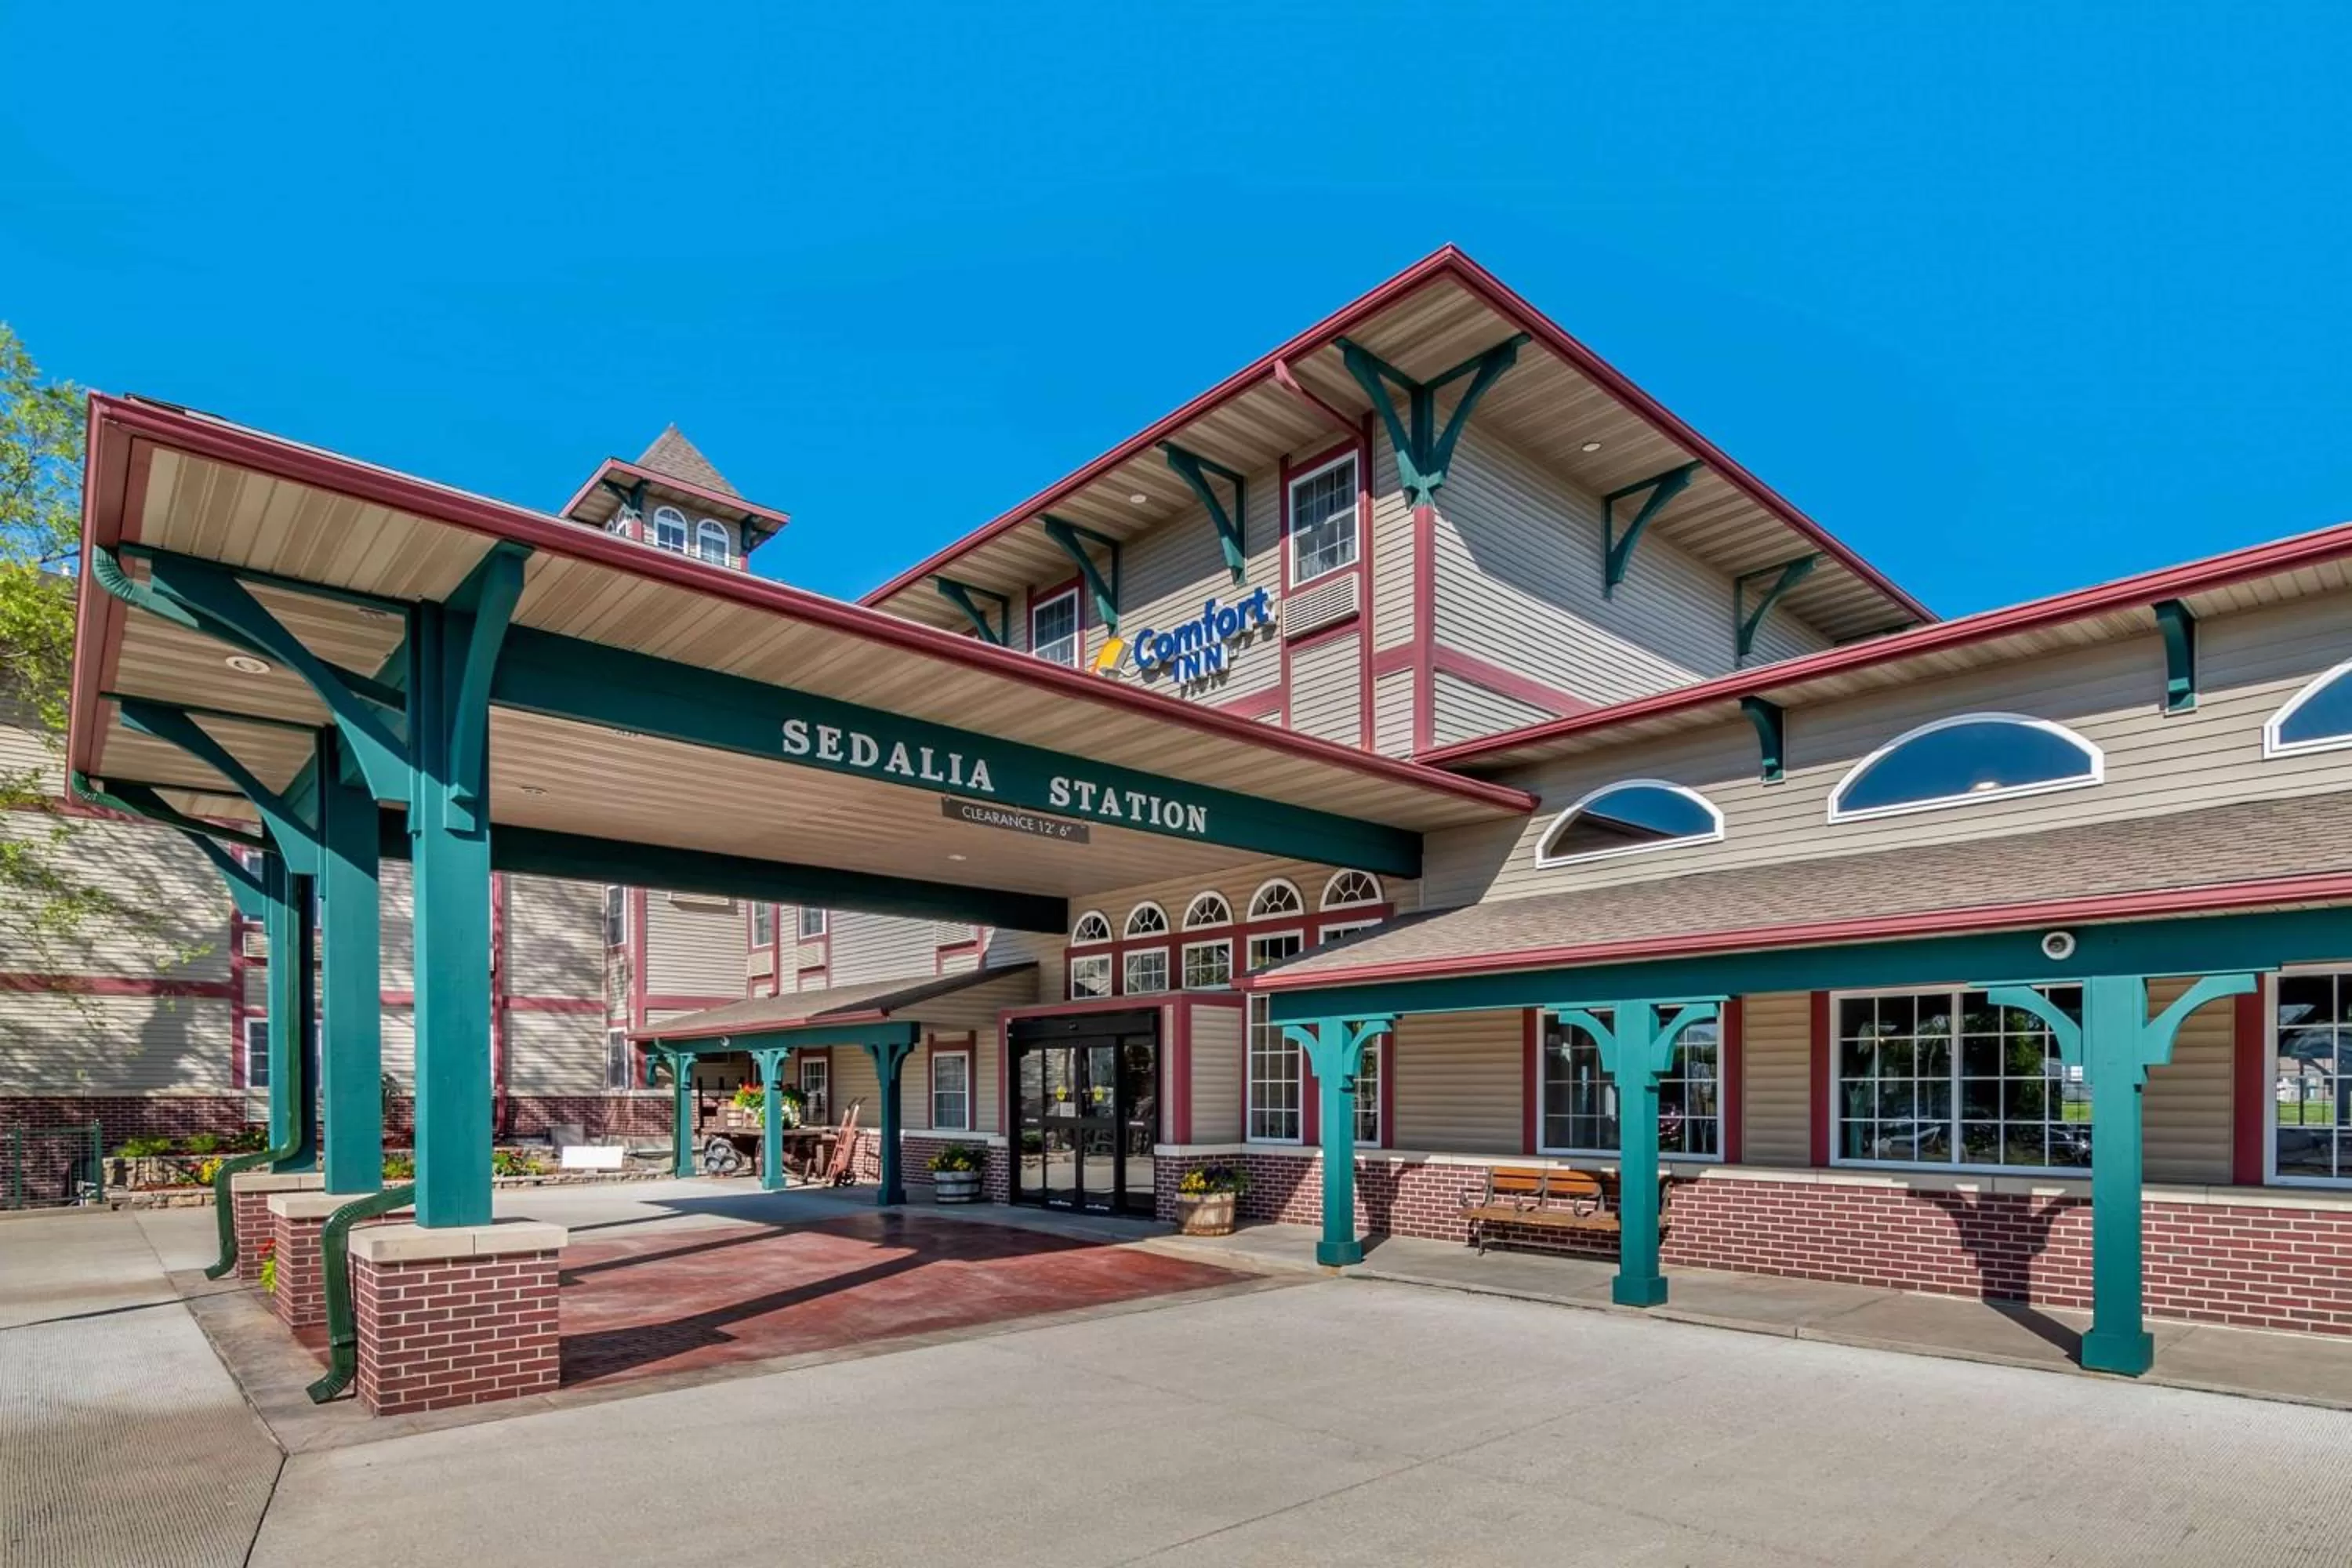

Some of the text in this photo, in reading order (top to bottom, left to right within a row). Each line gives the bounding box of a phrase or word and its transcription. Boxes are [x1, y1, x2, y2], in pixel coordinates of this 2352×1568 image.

[1134, 586, 1272, 671] Comfort
[1173, 643, 1224, 683] INN
[782, 718, 1208, 833] SEDALIA STATION
[962, 805, 1034, 831] CLEARANCE
